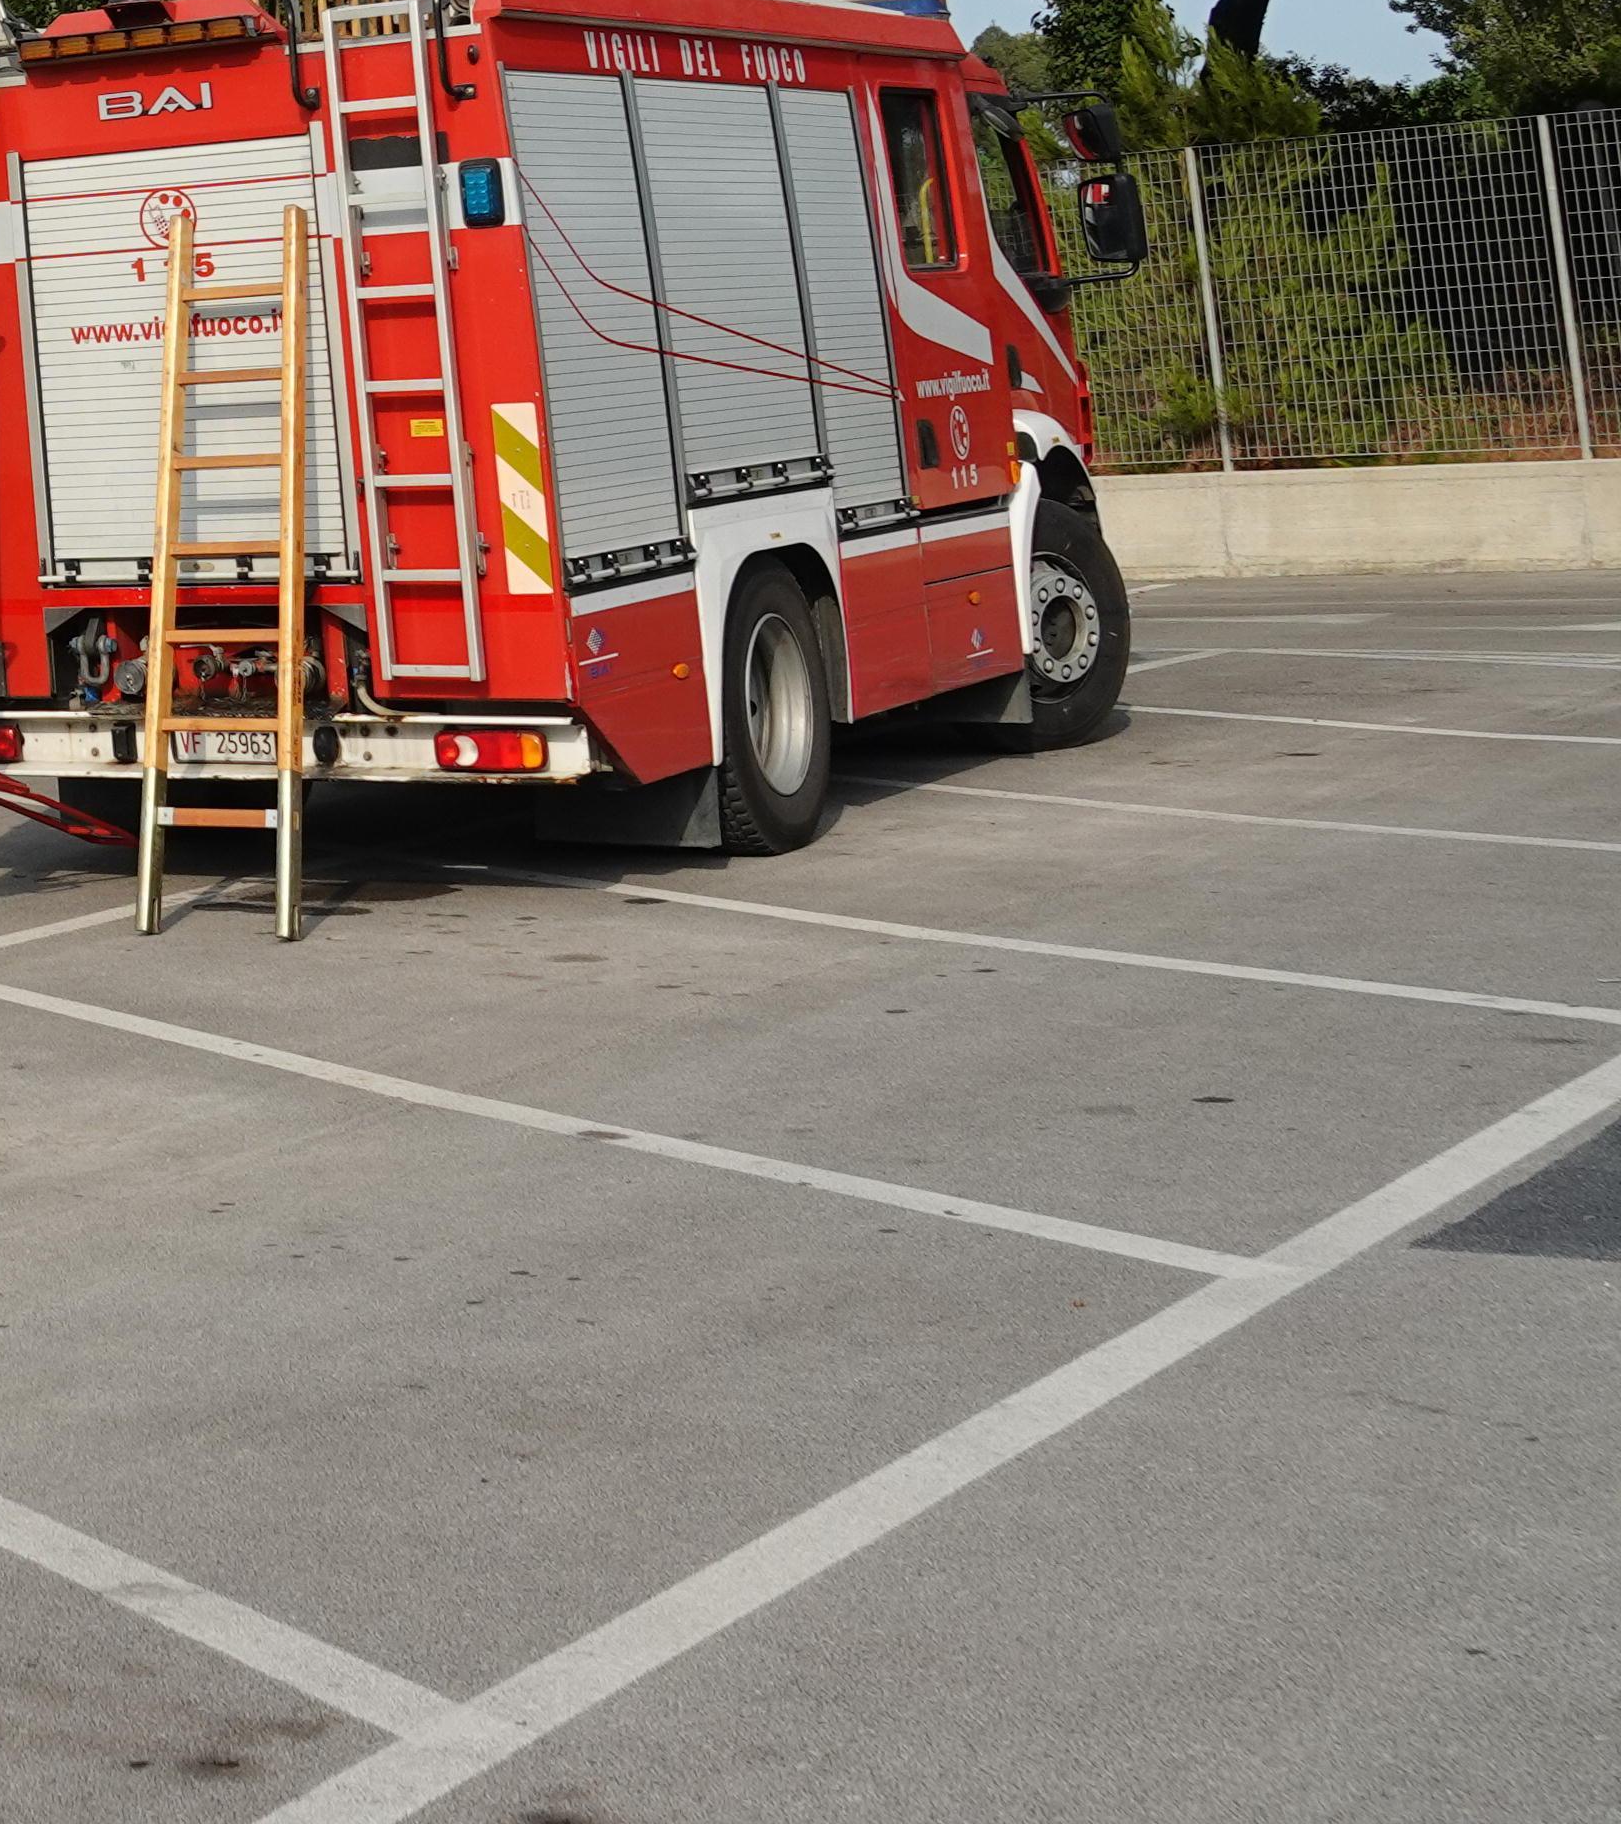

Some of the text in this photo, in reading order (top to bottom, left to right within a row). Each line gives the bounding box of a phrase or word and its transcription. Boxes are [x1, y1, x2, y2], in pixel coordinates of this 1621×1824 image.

[583, 30, 806, 84] VIGILI DEL FUOCO
[97, 81, 213, 121] BAI
[131, 251, 216, 283] 15
[71, 307, 283, 345] www.vifuoco.i
[915, 367, 991, 401] www.vigilfuoco.it
[951, 463, 978, 490] 115
[180, 730, 202, 754] VF
[215, 731, 272, 755] 25963
